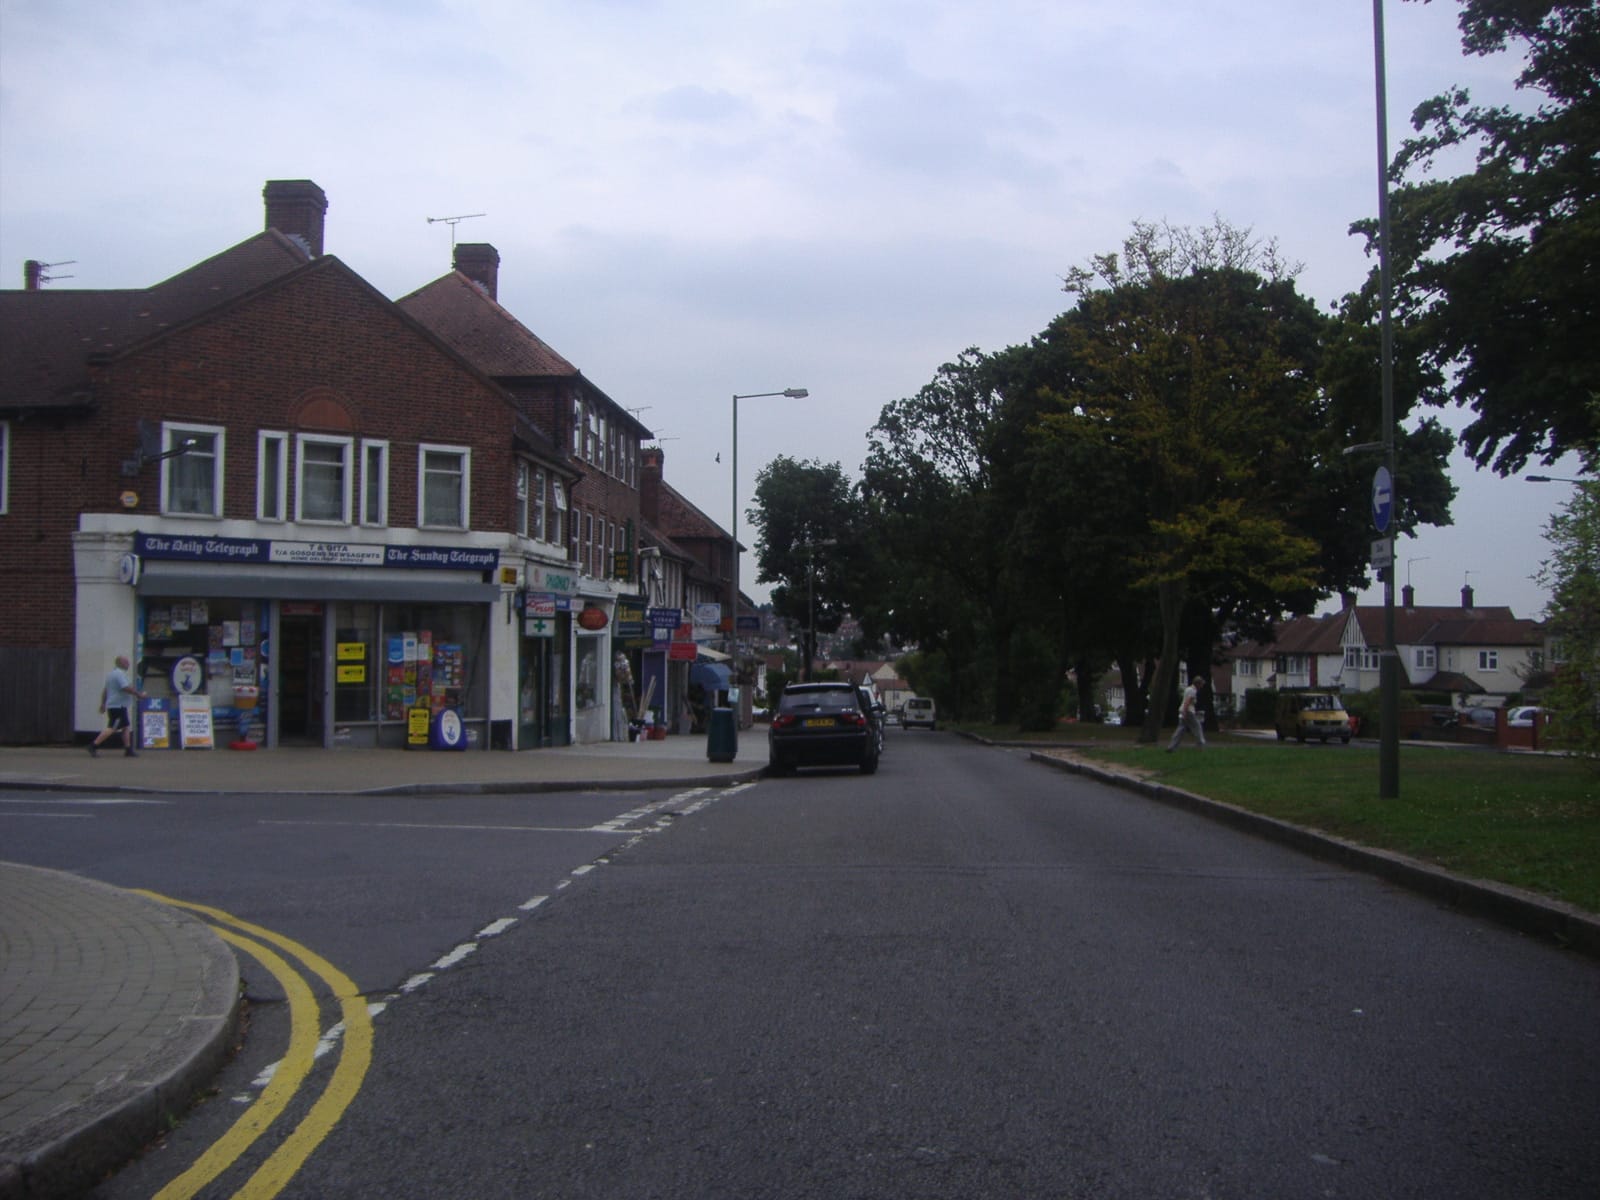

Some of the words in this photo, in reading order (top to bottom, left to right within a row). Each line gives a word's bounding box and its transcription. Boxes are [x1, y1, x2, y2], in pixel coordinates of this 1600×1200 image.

[145, 537, 169, 551] The
[172, 541, 203, 555] Daily
[205, 541, 259, 557] Telegraph
[328, 551, 381, 559] NEWSAGENTS
[388, 549, 408, 561] The
[411, 550, 448, 564] Sunday
[450, 551, 495, 565] Telegraph
